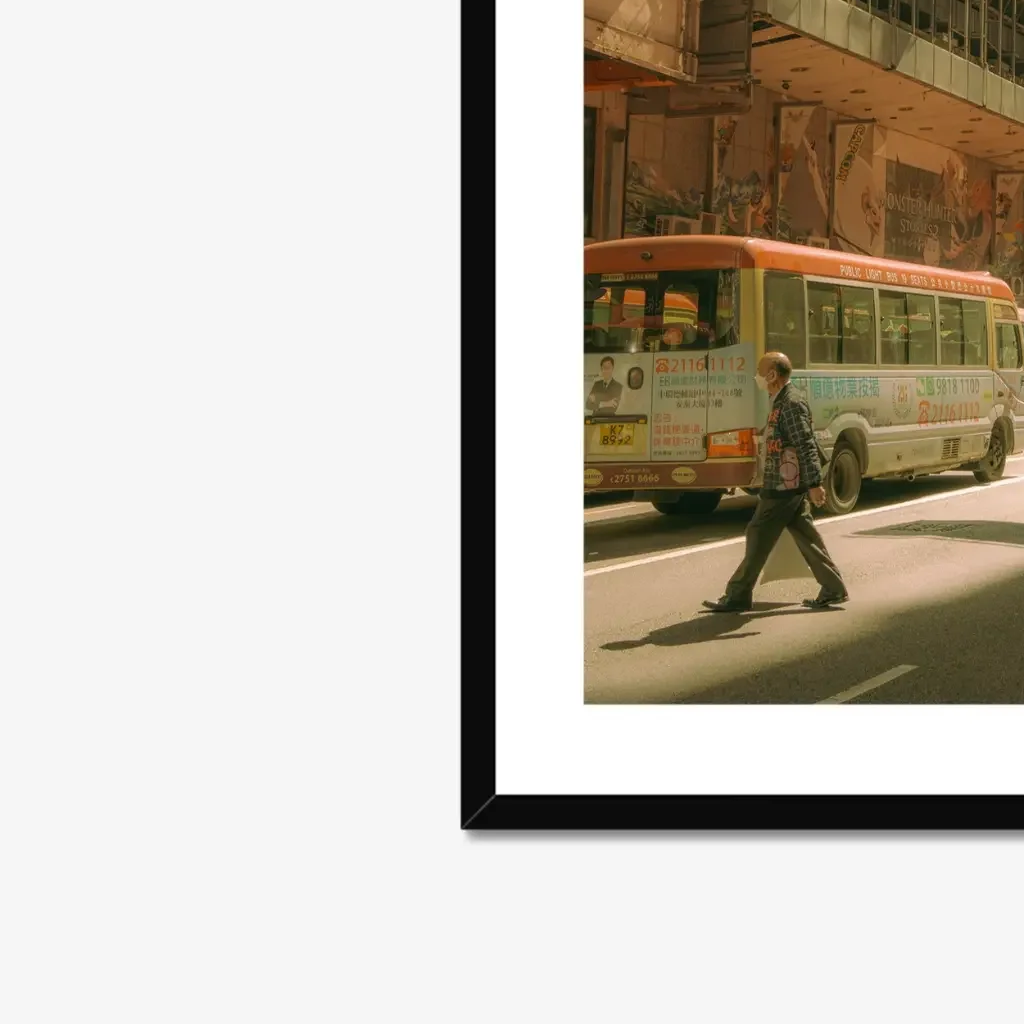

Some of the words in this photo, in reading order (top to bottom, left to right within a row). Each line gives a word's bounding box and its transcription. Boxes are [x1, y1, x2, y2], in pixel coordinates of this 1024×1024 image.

[839, 264, 862, 278] PUBLIC
[865, 267, 882, 281] LIGHT
[887, 271, 899, 283] BUS
[910, 275, 928, 287] SEATS
[671, 358, 705, 373] 2116
[711, 356, 746, 372] 1112
